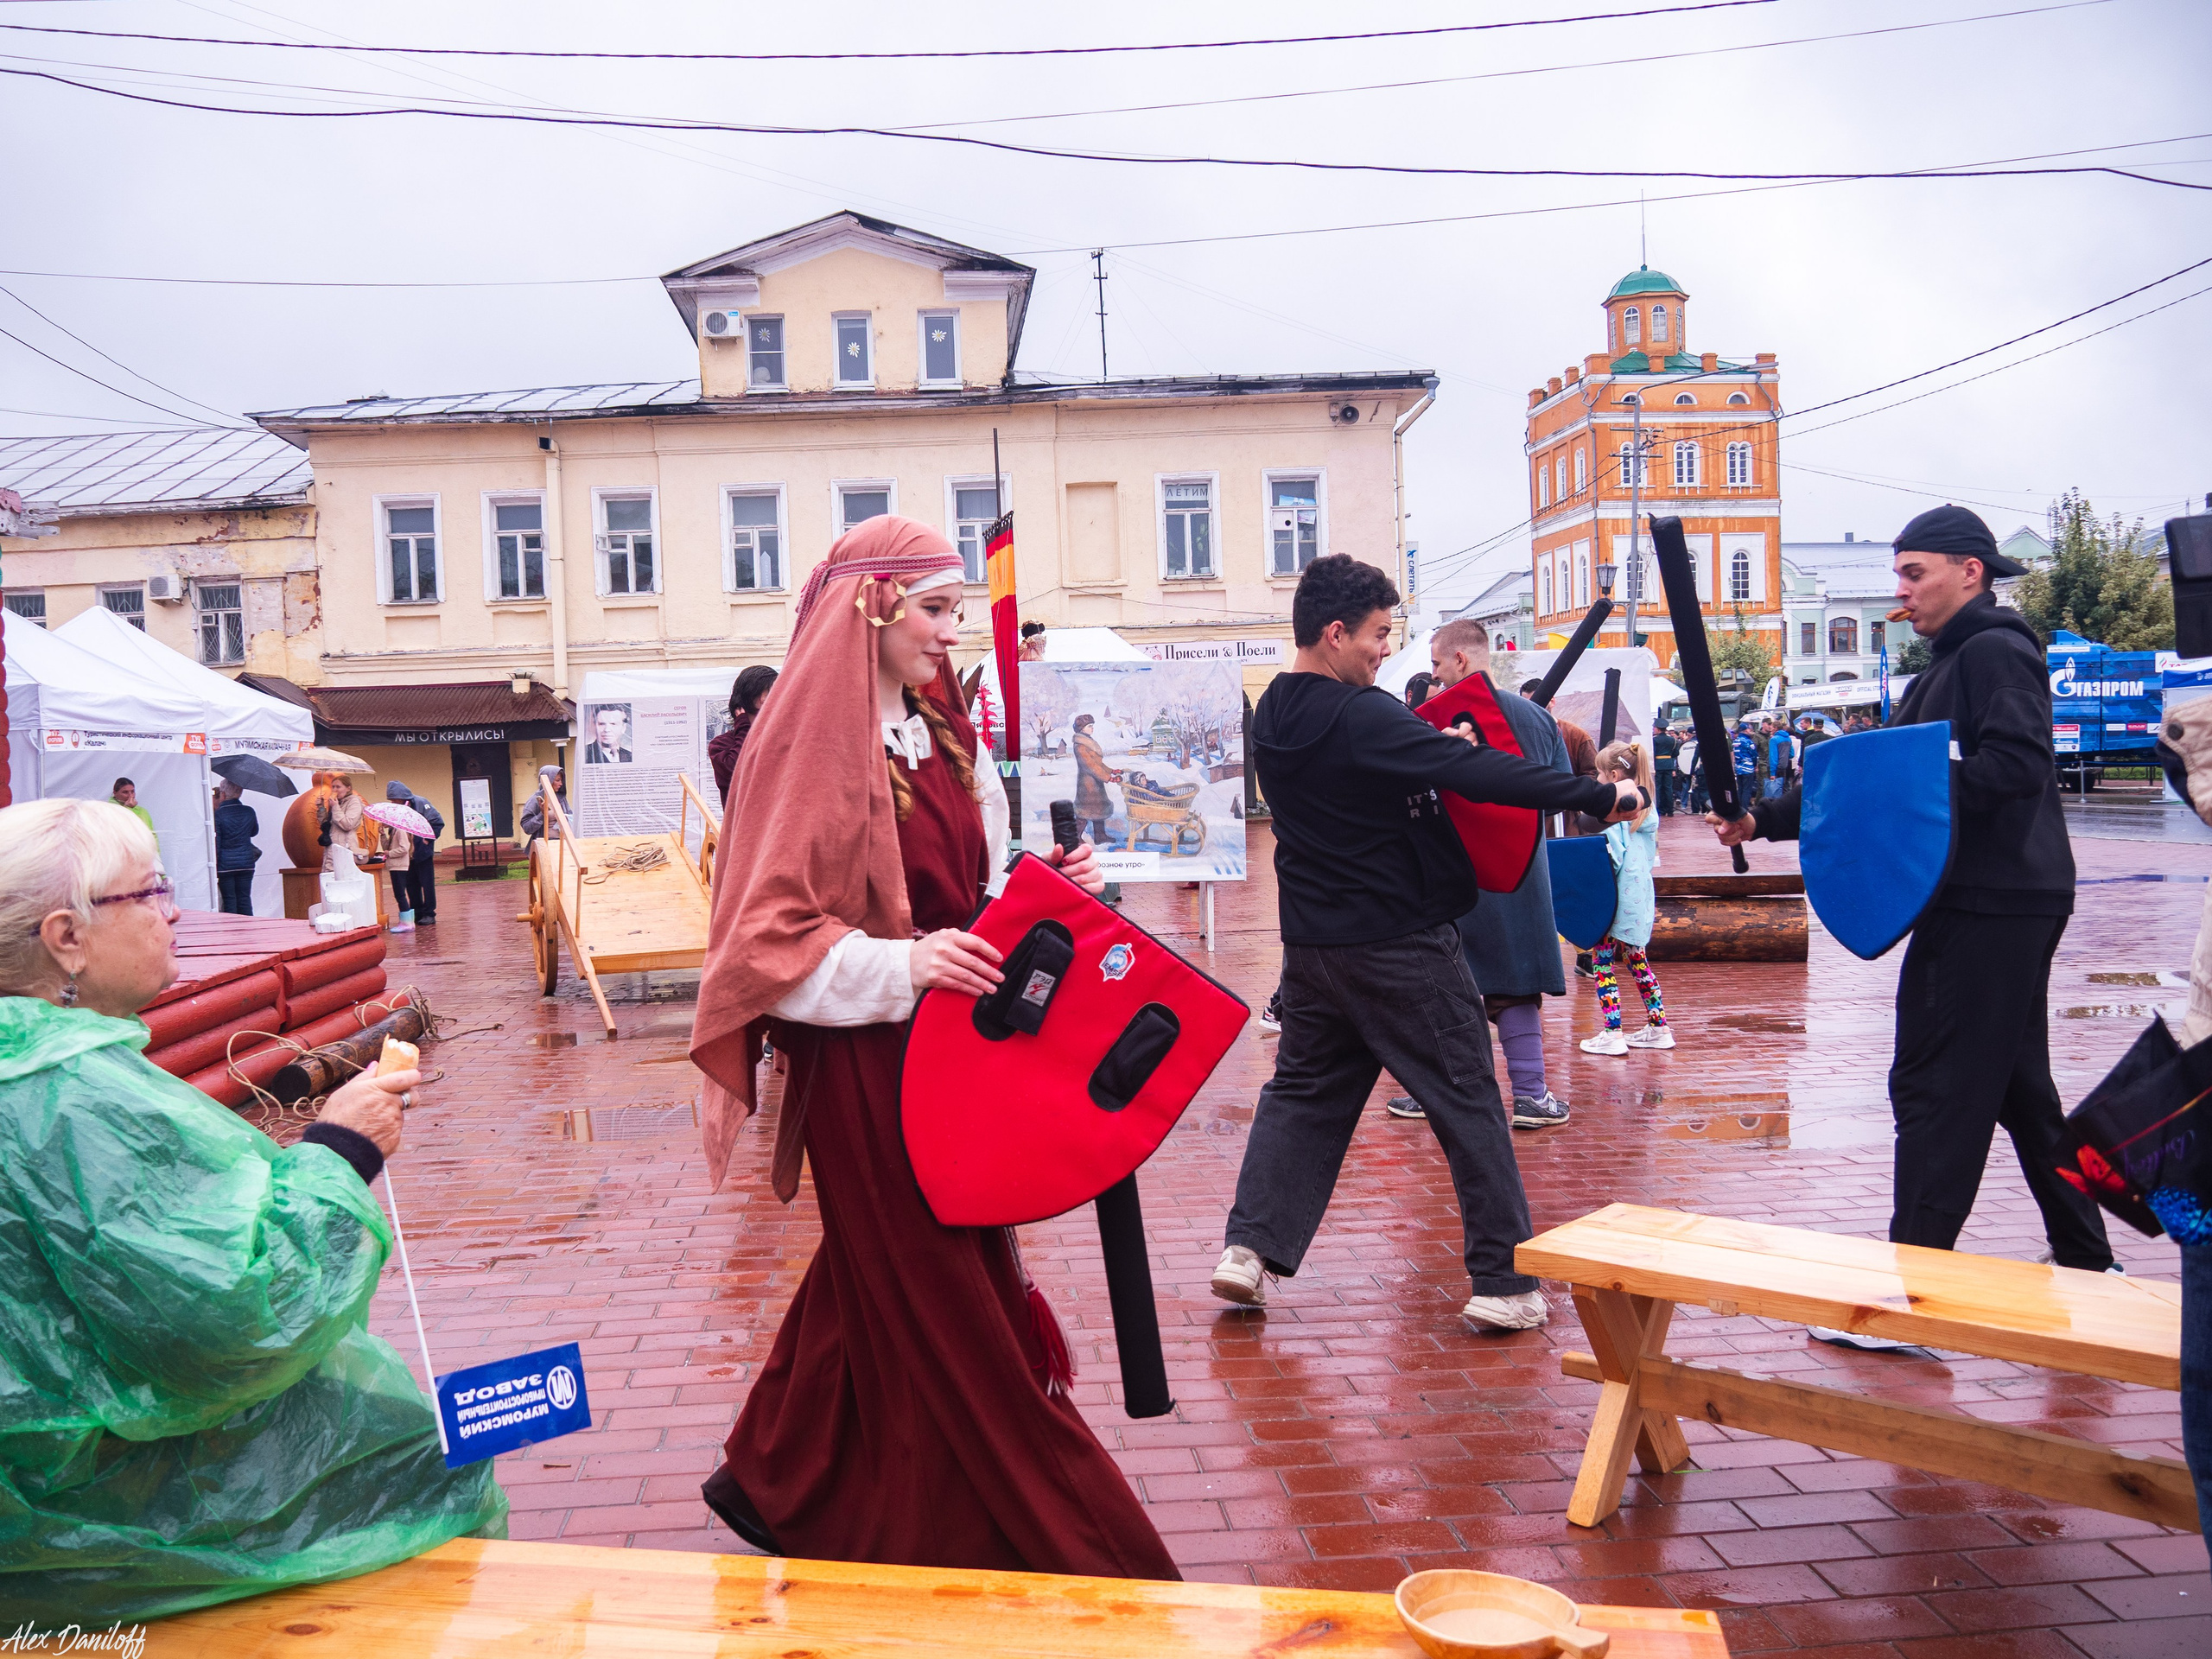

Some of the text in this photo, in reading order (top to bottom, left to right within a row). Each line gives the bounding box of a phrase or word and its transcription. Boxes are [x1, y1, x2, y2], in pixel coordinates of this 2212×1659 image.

[1166, 487, 1208, 498] ЛЕТИМ
[1165, 645, 1219, 661] Присели
[1236, 642, 1276, 657] Поели
[2075, 681, 2144, 697] ГАЗПРОМ
[395, 729, 505, 742] МЫ ОТКРЫЛИСЬ!
[454, 1373, 543, 1406] ЗАВОД
[456, 1388, 547, 1424] ПРИБОРОСТРОИТЕЛЬНЫЙ
[459, 1402, 550, 1440] МУРОМСКИЙ
